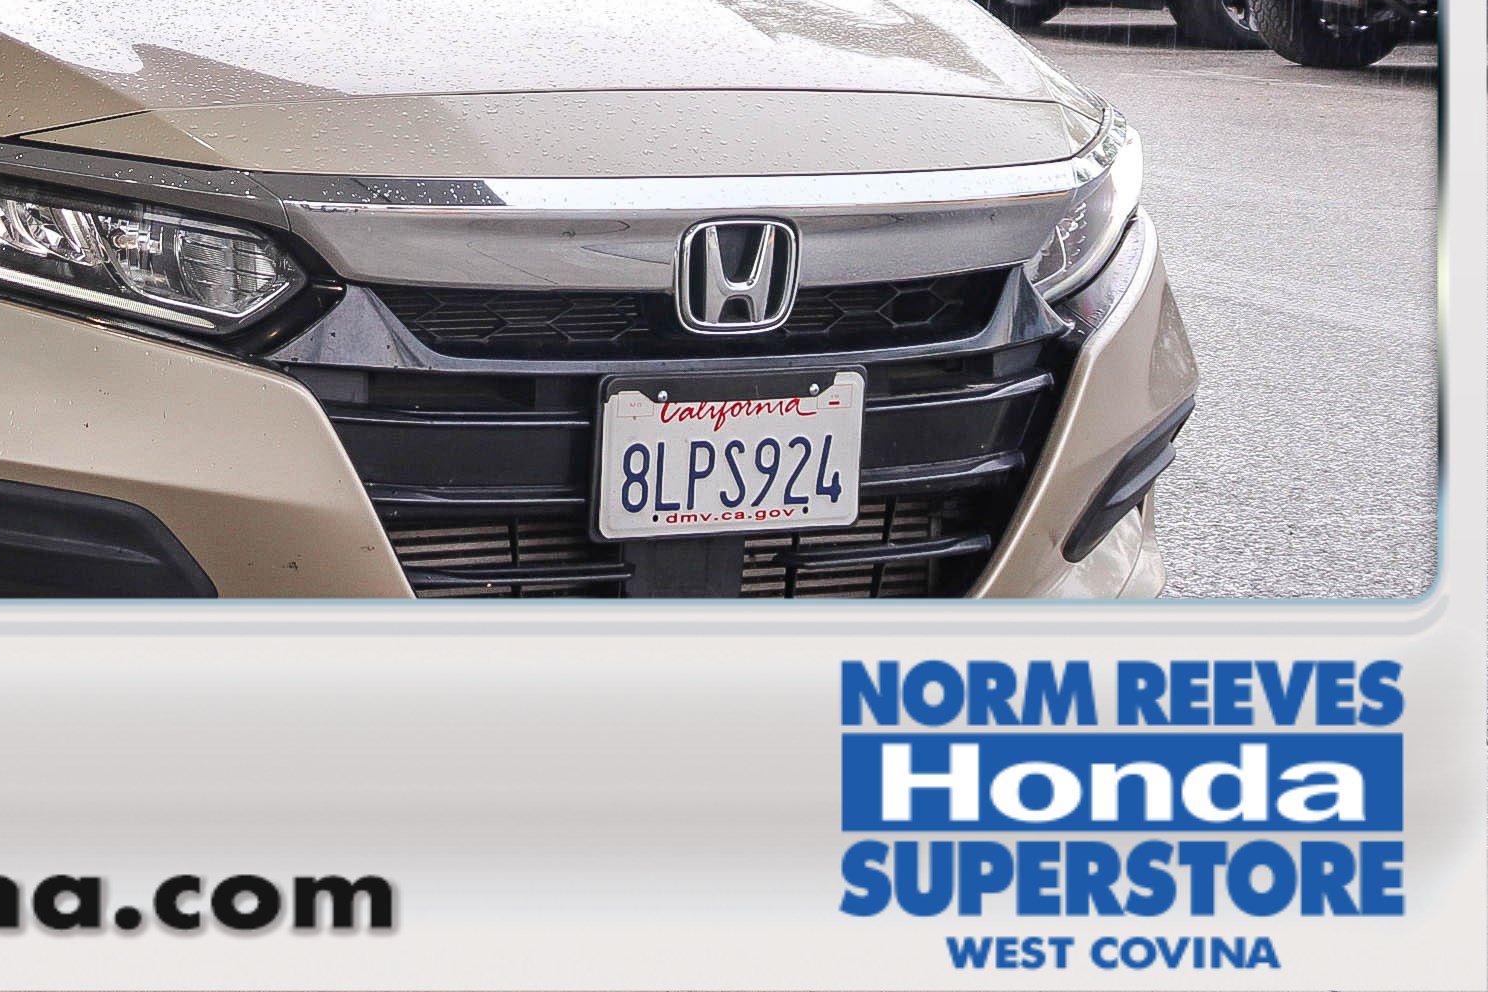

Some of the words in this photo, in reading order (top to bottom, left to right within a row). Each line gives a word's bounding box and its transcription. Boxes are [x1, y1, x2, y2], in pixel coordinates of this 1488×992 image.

[661, 397, 816, 432] California
[621, 434, 842, 513] 8LPS924
[665, 507, 795, 524] dmv.ca.gov
